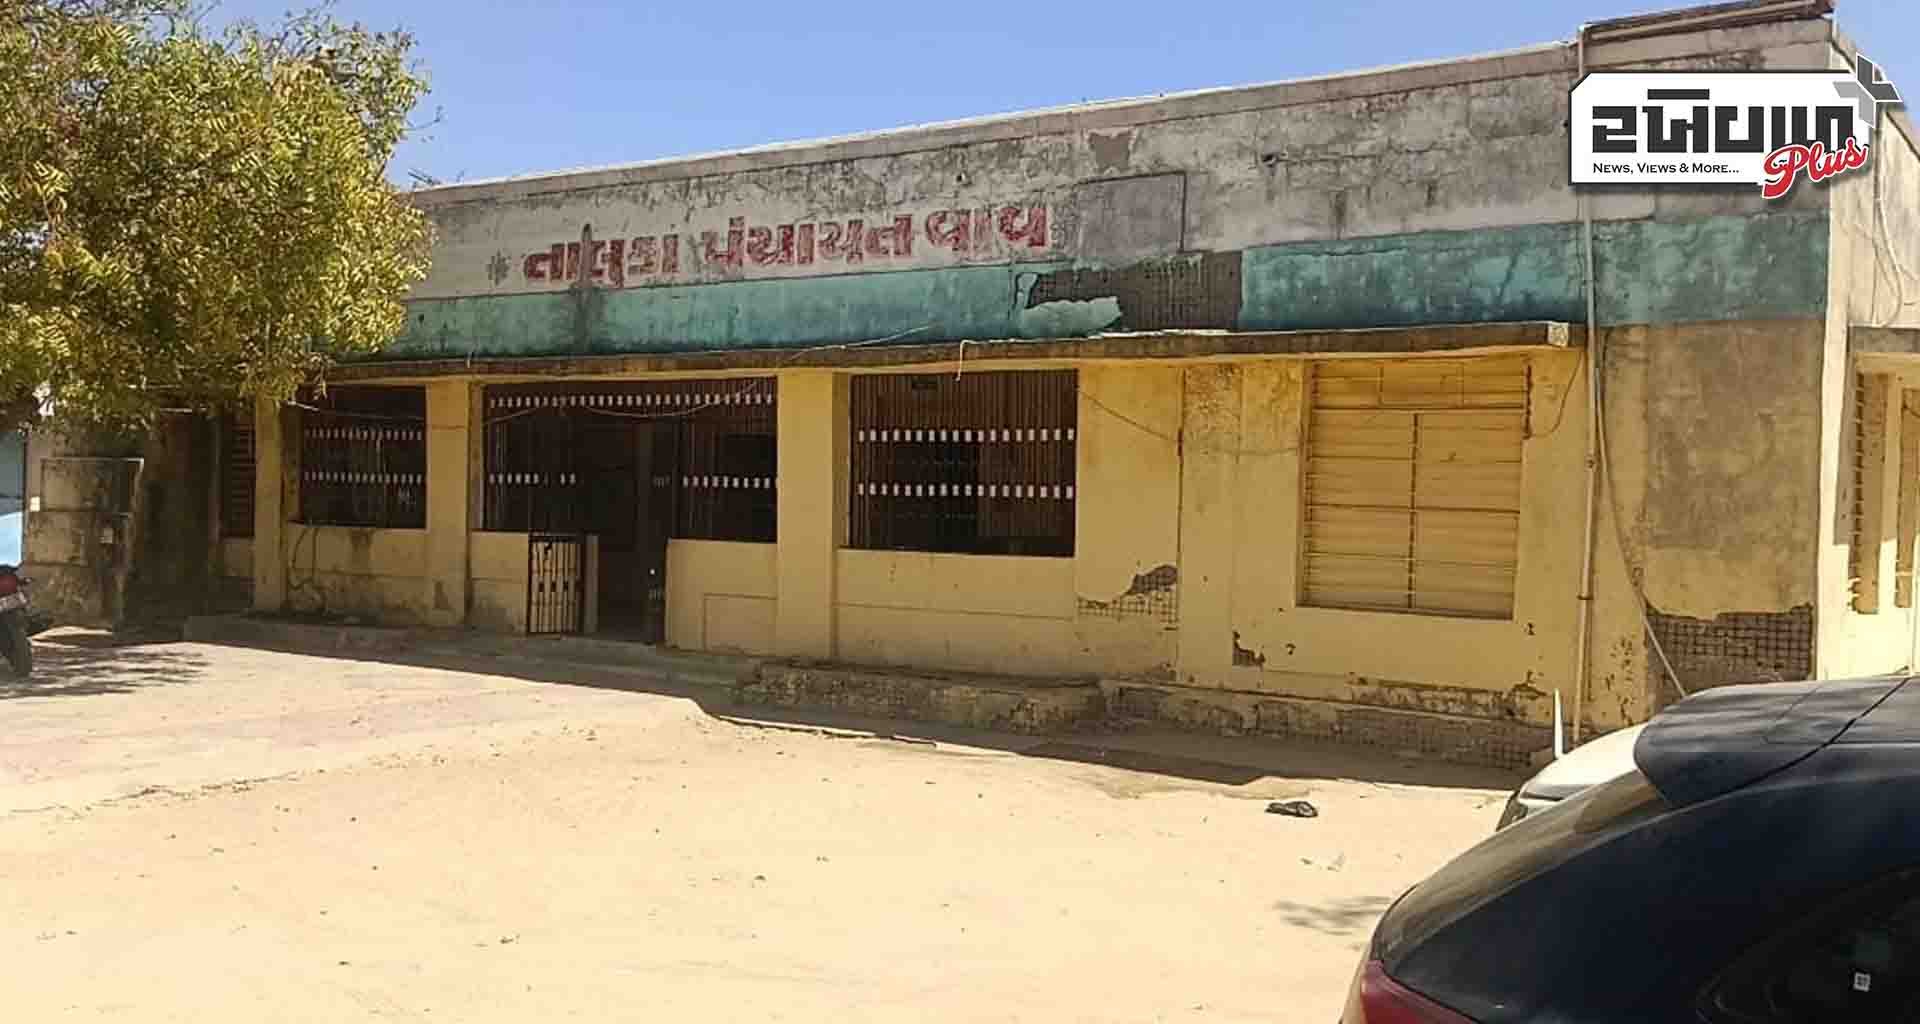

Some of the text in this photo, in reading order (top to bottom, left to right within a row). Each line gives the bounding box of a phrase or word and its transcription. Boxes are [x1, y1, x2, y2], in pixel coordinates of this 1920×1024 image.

[523, 206, 1047, 288] તાલુકા પંચાયત વાવ
